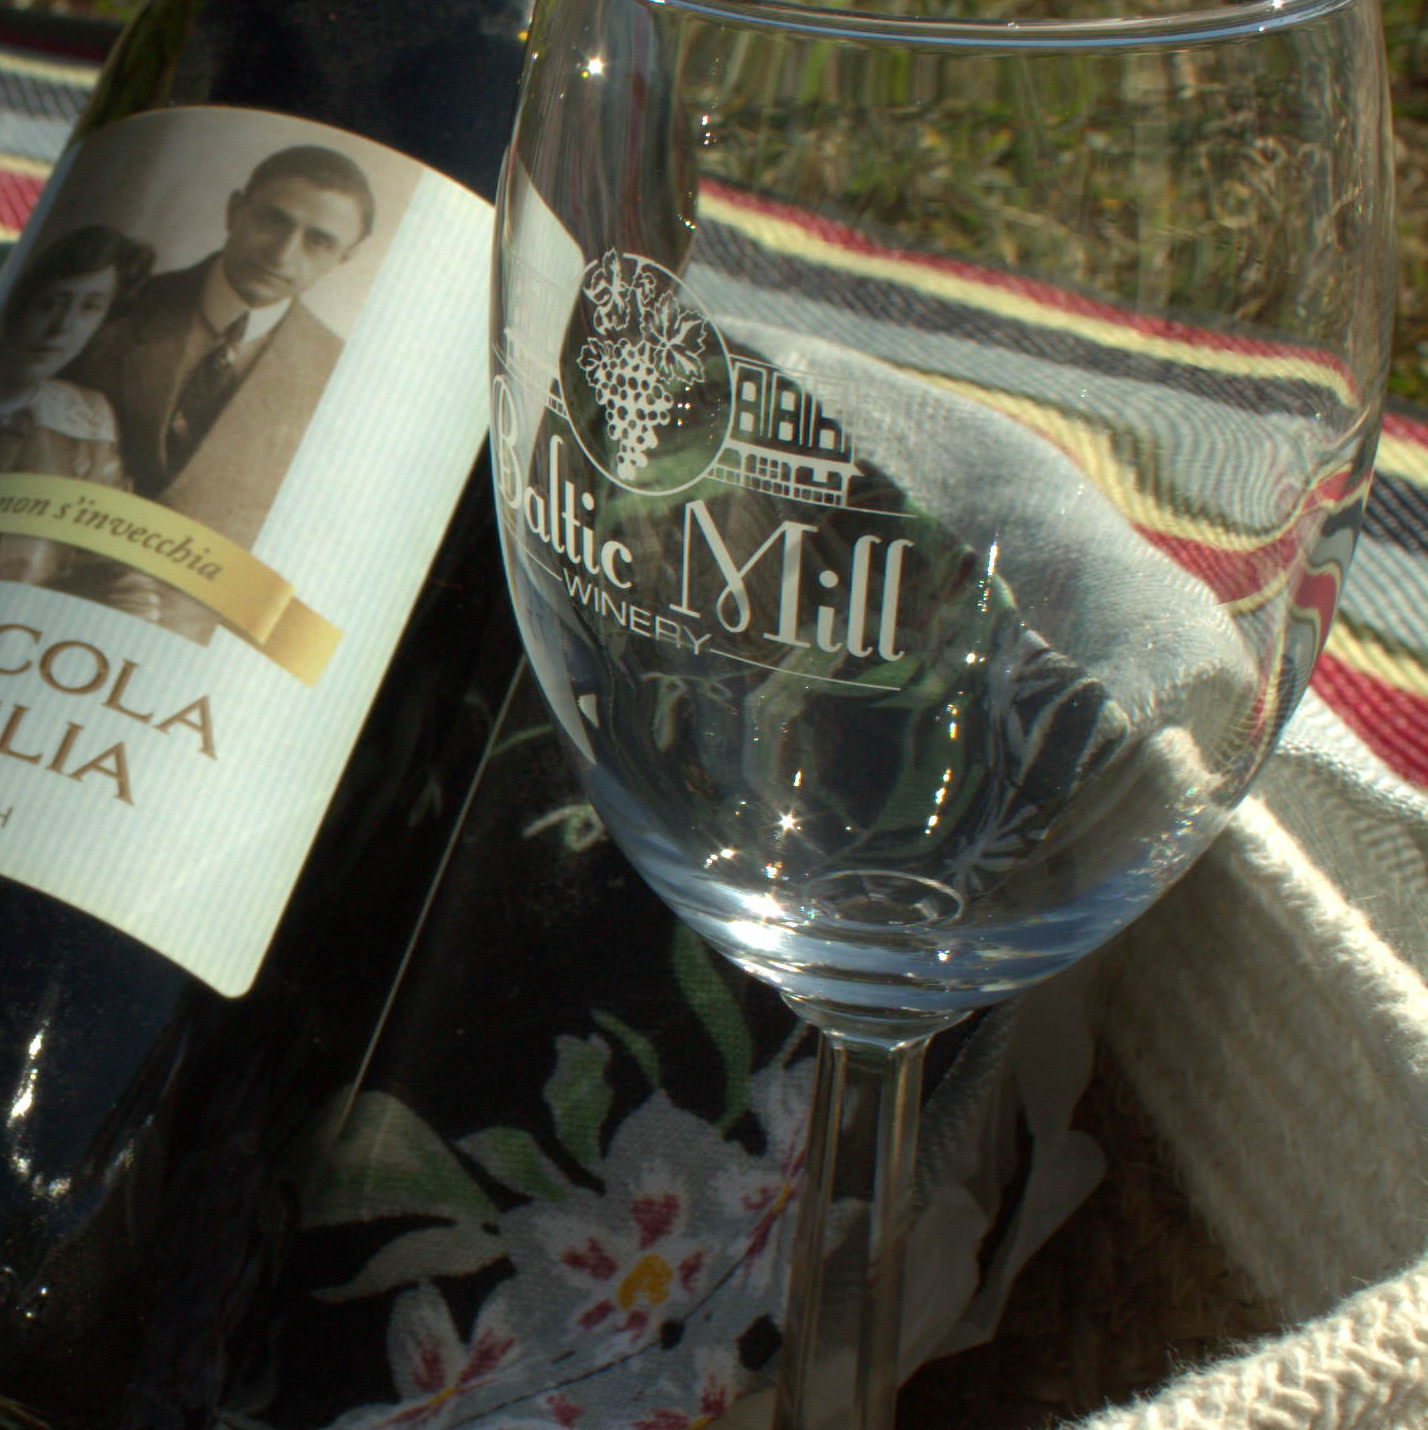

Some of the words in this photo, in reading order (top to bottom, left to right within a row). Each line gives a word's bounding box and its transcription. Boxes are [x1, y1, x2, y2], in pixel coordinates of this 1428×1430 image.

[492, 374, 633, 590] Baltic
[669, 499, 915, 662] Mill
[562, 567, 711, 656] WINERY
